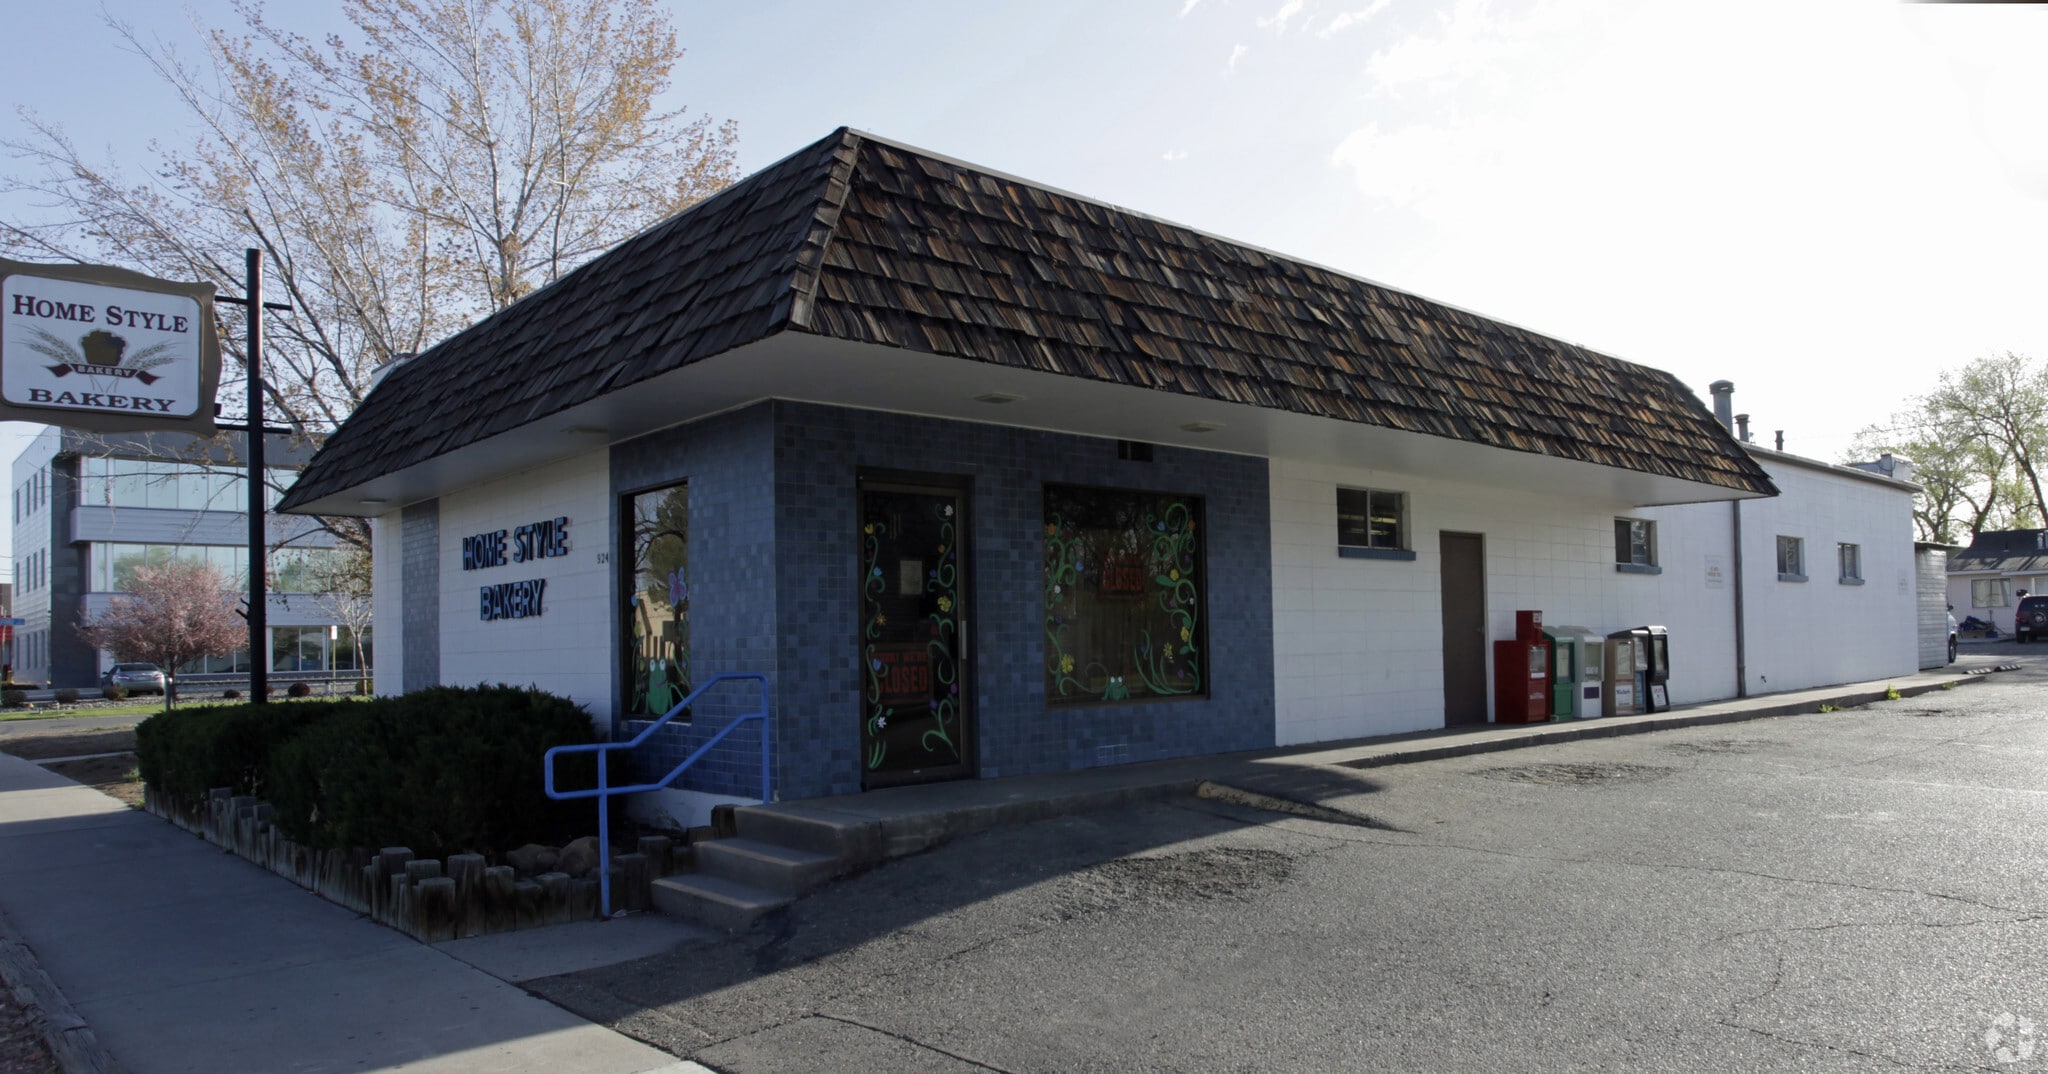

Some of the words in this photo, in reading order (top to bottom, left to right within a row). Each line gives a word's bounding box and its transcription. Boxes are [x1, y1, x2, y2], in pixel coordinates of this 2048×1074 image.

[12, 294, 95, 323] HOME
[106, 305, 189, 334] STYLE
[77, 365, 132, 377] BAKERY
[29, 388, 176, 412] BAKERY
[462, 529, 507, 571] HOME
[513, 516, 568, 563] STYLE
[480, 578, 546, 621] BAKERY
